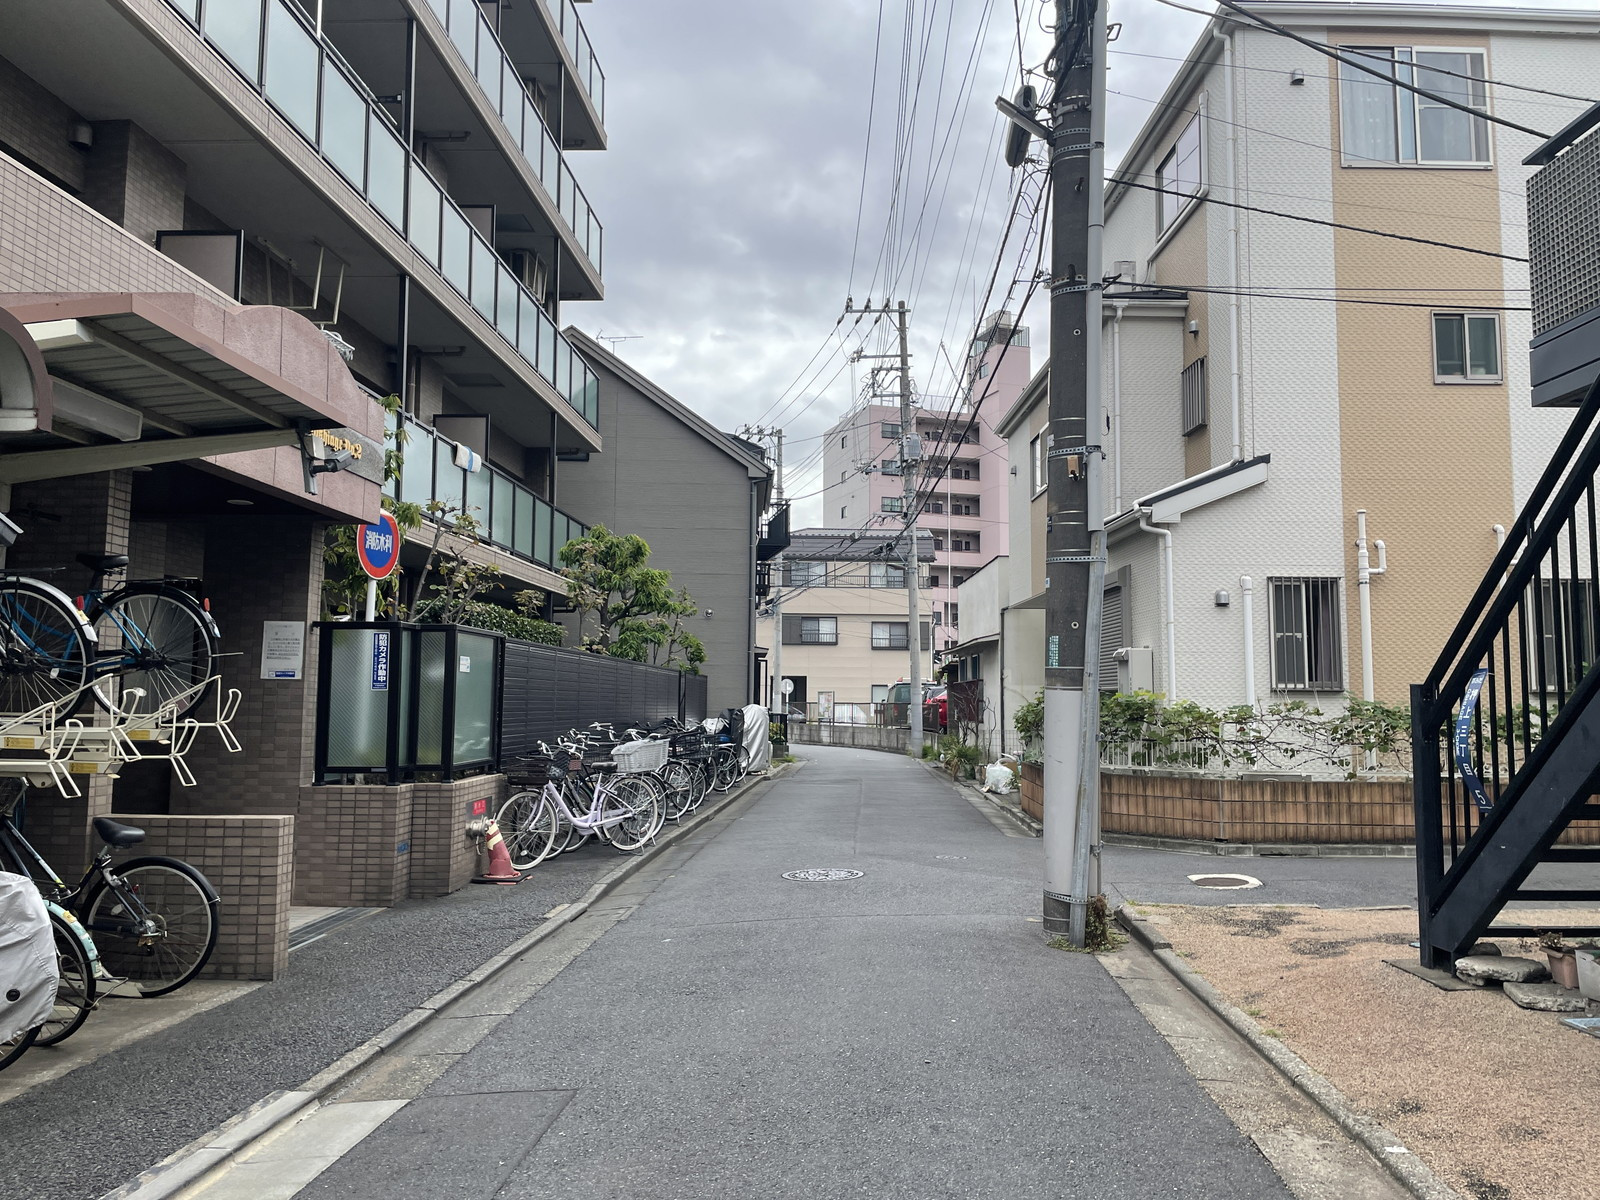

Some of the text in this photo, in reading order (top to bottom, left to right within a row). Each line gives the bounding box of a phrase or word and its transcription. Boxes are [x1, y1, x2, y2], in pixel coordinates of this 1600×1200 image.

[365, 530, 393, 554] 消防水利
[378, 633, 388, 682] 防犯カメラ作動中
[1460, 688, 1479, 776] 押上三丁目
[1475, 789, 1486, 805] 5
